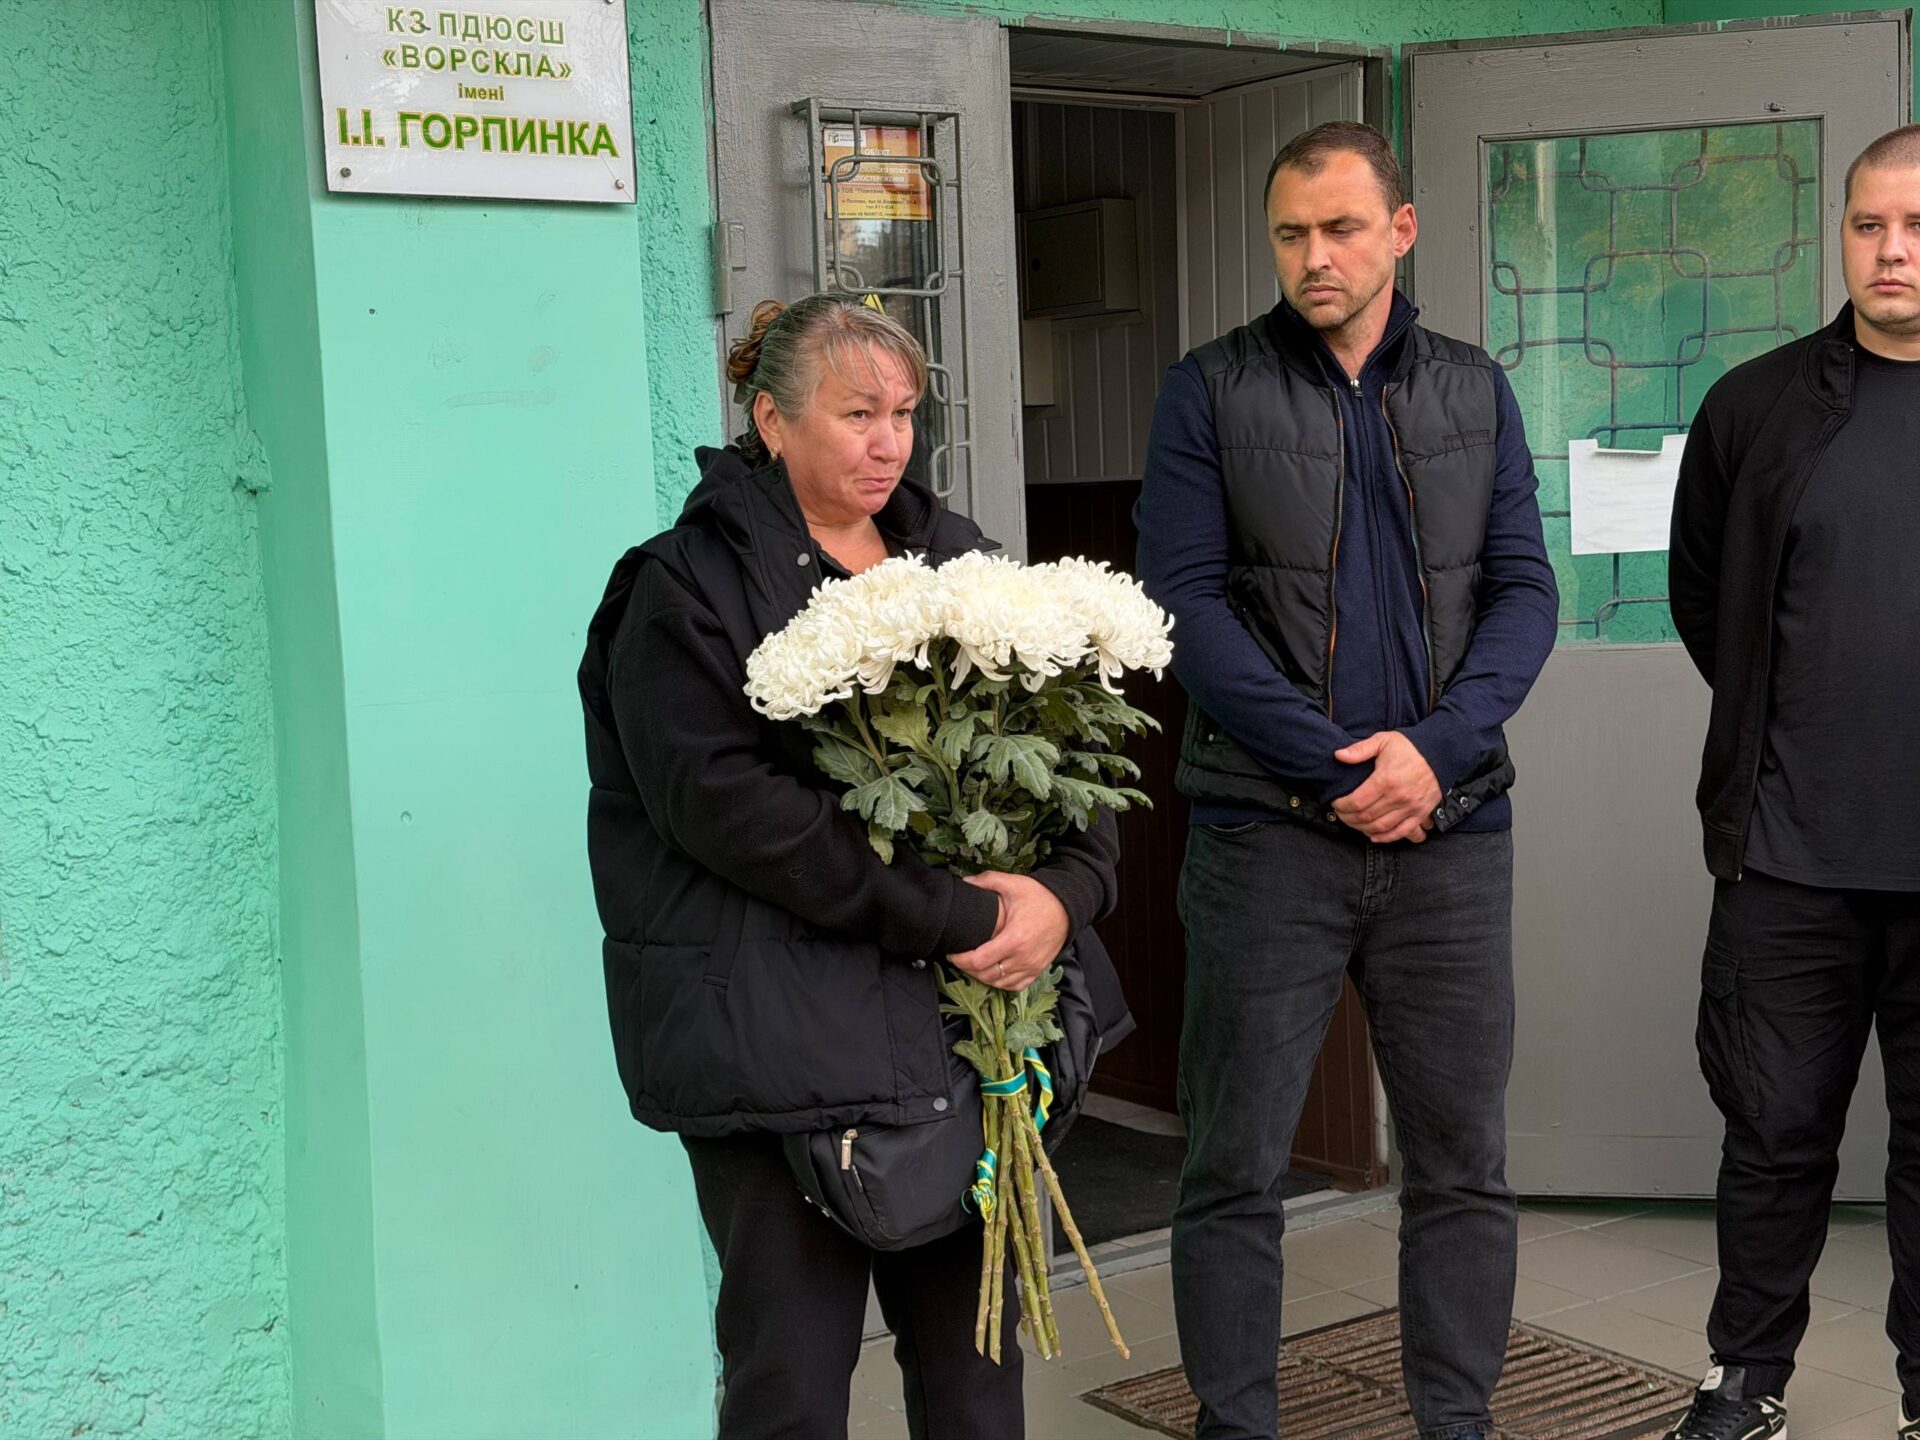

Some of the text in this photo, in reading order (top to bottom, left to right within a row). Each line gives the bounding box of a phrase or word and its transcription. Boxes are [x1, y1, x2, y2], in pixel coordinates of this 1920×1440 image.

[386, 7, 565, 45] КЗ ПДЮСШ
[381, 44, 572, 80] «ВОРСКЛА»
[458, 83, 505, 101] імені
[398, 111, 620, 158] ГОРПИНКА
